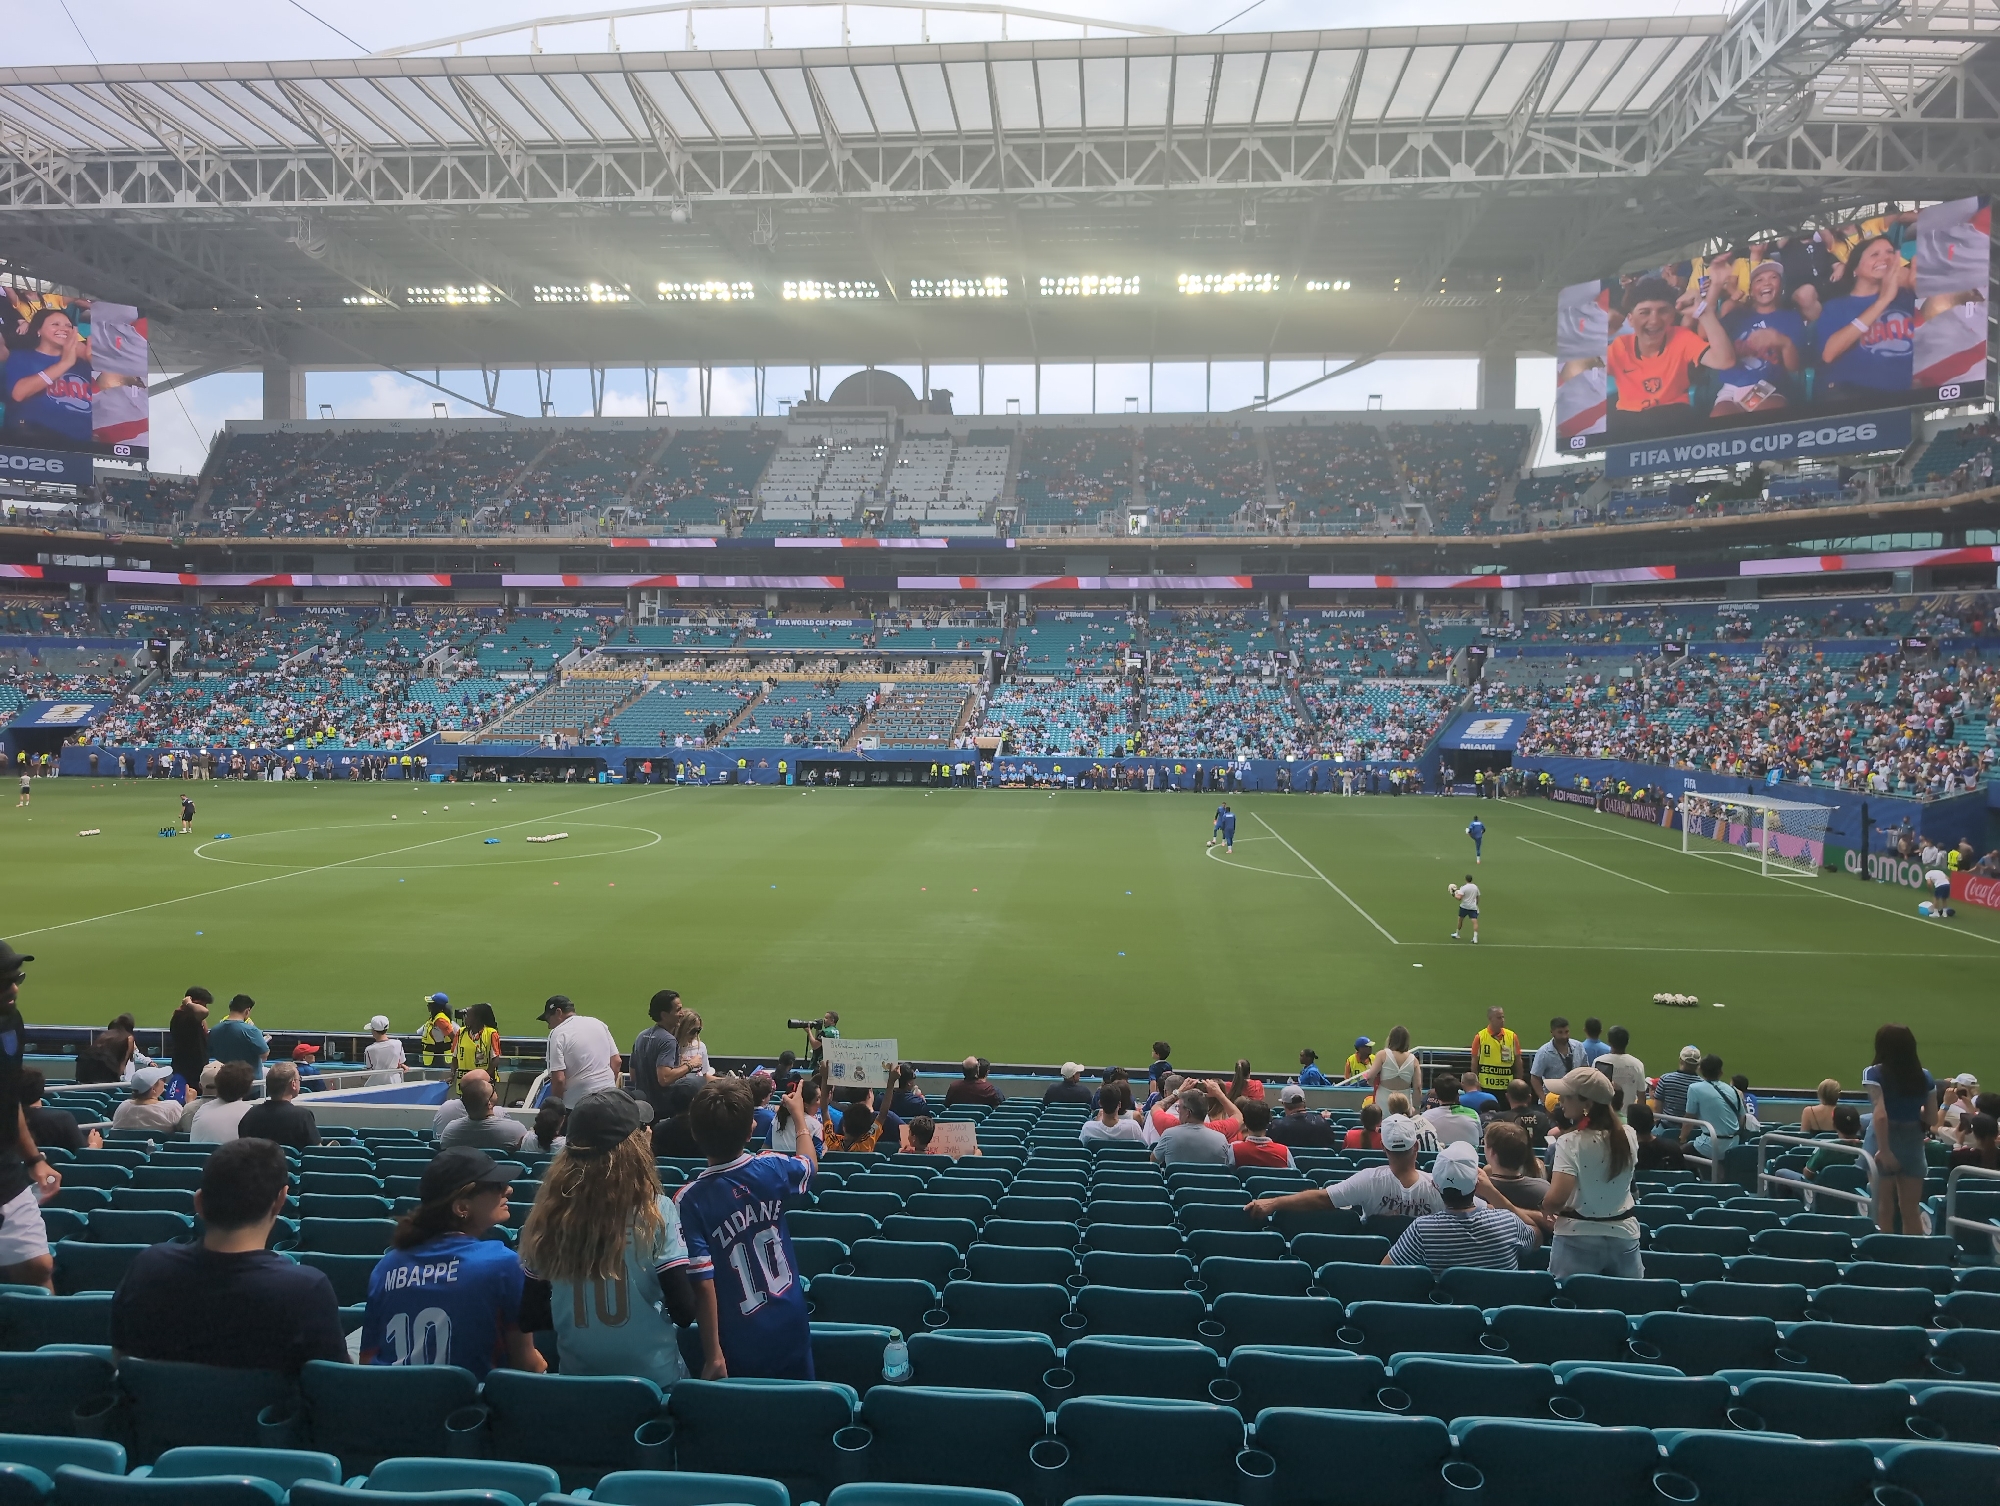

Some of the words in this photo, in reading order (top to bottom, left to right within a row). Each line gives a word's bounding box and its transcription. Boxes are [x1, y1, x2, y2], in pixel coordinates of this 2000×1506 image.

[1941, 387, 1958, 398] CC
[1572, 438, 1584, 447] CC
[1629, 448, 1670, 467] FIFA
[1673, 439, 1747, 462] WORLD
[1750, 433, 1793, 453] CUP
[1797, 423, 1878, 448] 2026
[115, 446, 129, 455] CC
[1321, 610, 1366, 618] MIAMI
[1460, 742, 1496, 751] MIAMI
[1227, 761, 1252, 771] FIFA
[1684, 778, 1697, 790] FIFA
[1553, 789, 1566, 801] ADI
[1604, 797, 1626, 814] QATAR
[1629, 802, 1657, 822] IRWAYS
[1485, 1077, 1510, 1086] 10353
[712, 1200, 782, 1249] ZIDANE
[385, 1256, 460, 1293] MBAPPÉ
[729, 1225, 793, 1316] 10
[386, 1307, 452, 1366] 10
